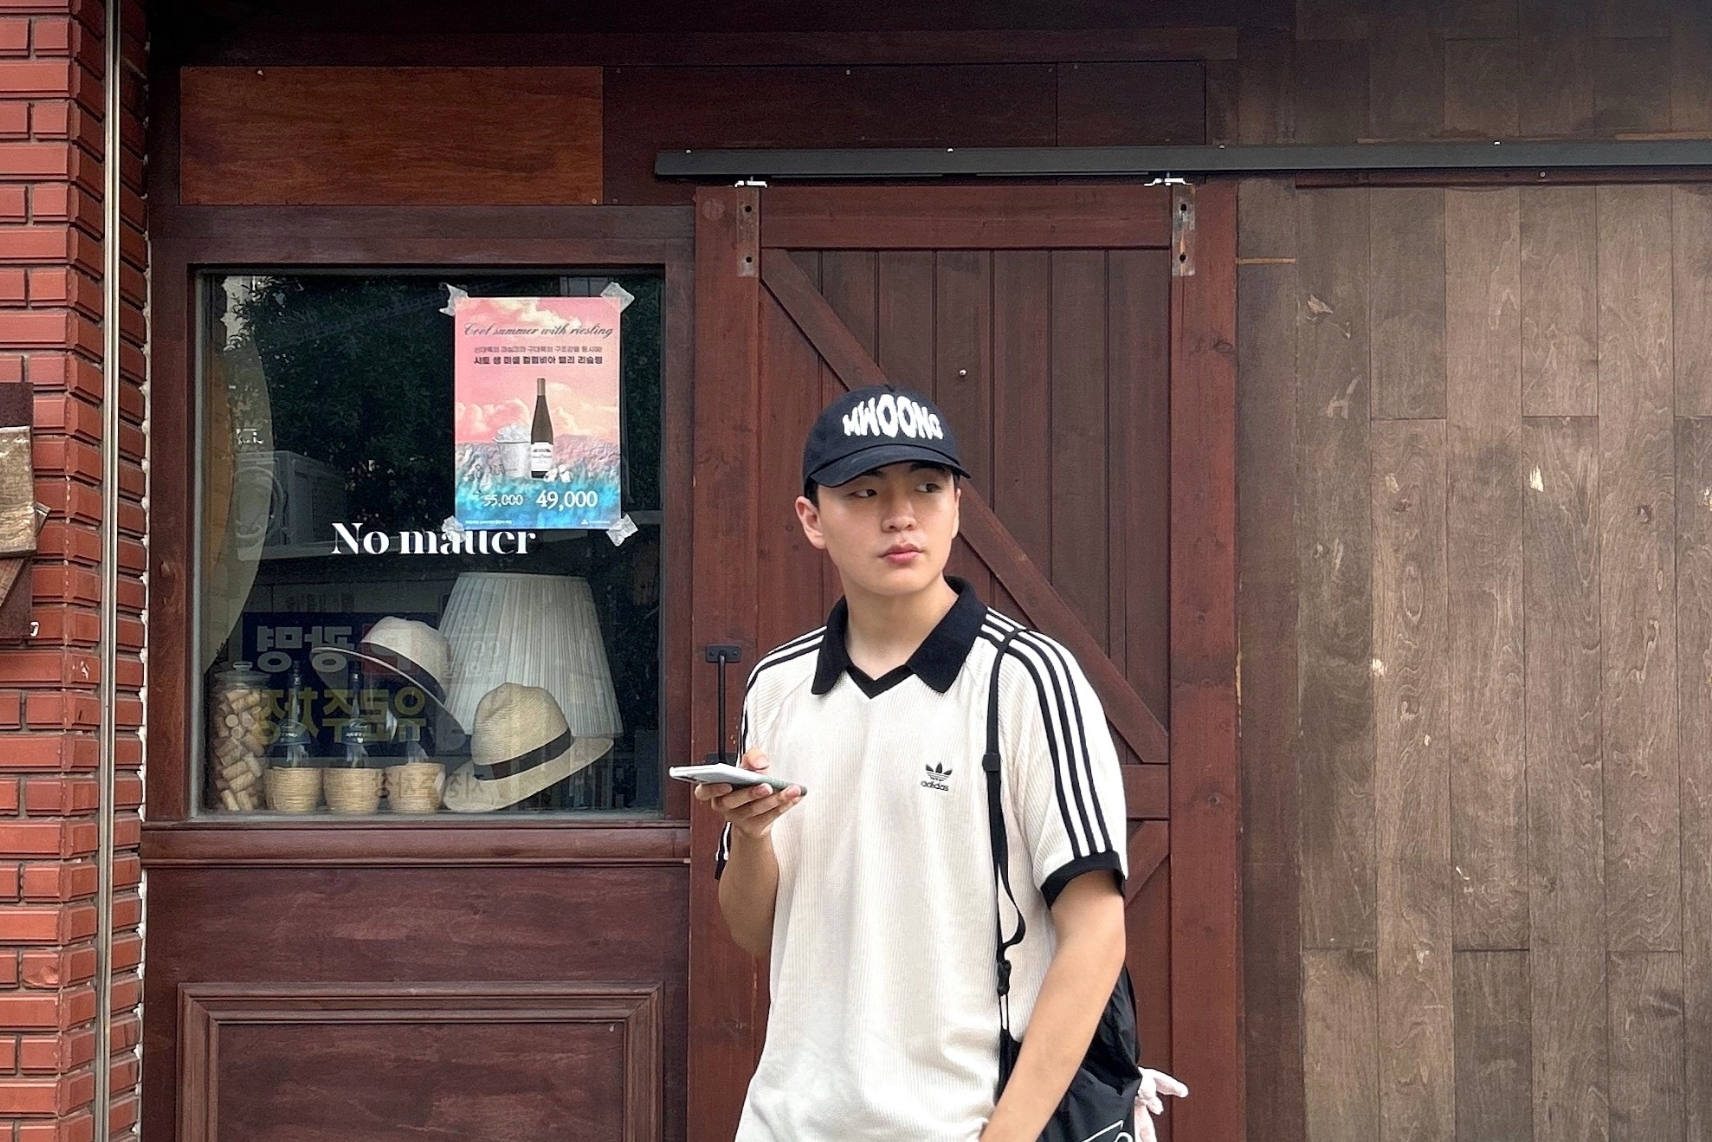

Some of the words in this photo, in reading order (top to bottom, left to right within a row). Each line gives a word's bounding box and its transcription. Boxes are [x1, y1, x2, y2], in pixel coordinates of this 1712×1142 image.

[464, 322, 496, 336] Cool
[493, 326, 540, 336] summer
[541, 323, 571, 336] with
[570, 323, 614, 339] riesling
[536, 489, 598, 512] 49,000
[332, 523, 390, 554] No
[920, 780, 949, 792] adidas
